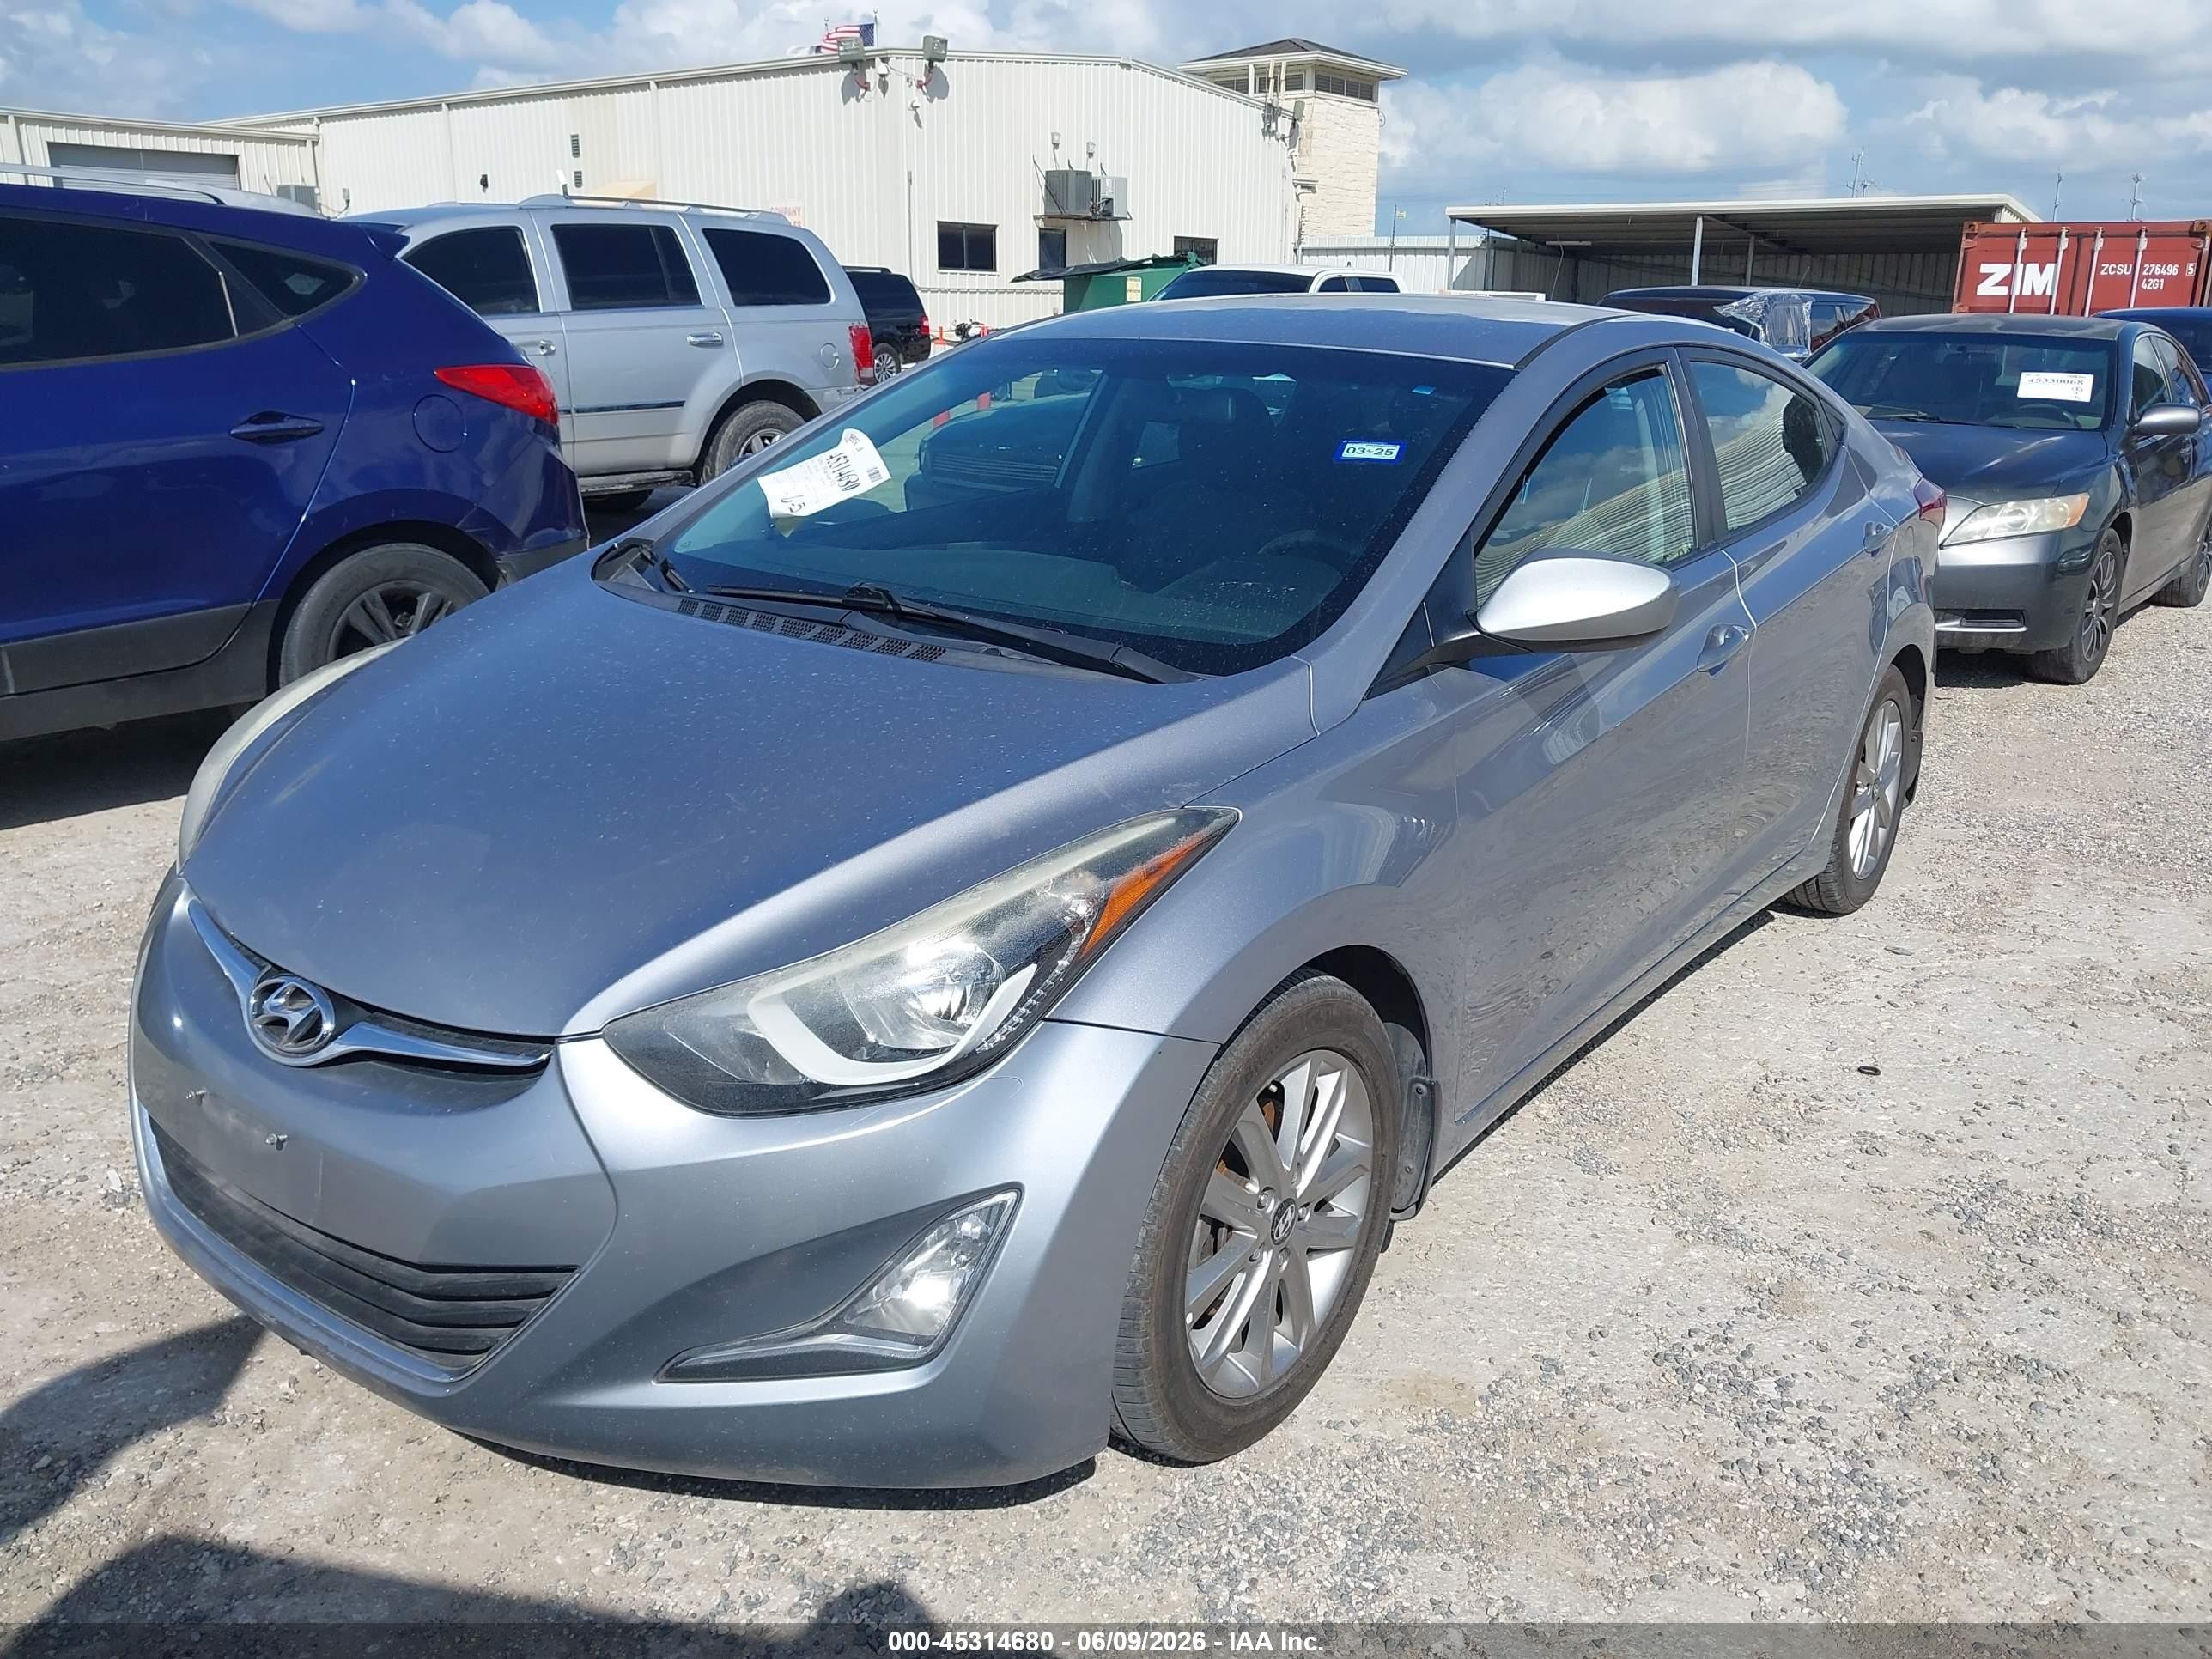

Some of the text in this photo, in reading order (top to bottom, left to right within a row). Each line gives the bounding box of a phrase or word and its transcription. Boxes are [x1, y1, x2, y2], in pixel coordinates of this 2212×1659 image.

[2100, 264, 2133, 276] ZCSU
[2142, 264, 2179, 276] 276496
[1976, 263, 2058, 296] ZIM
[2141, 278, 2164, 289] 42G1
